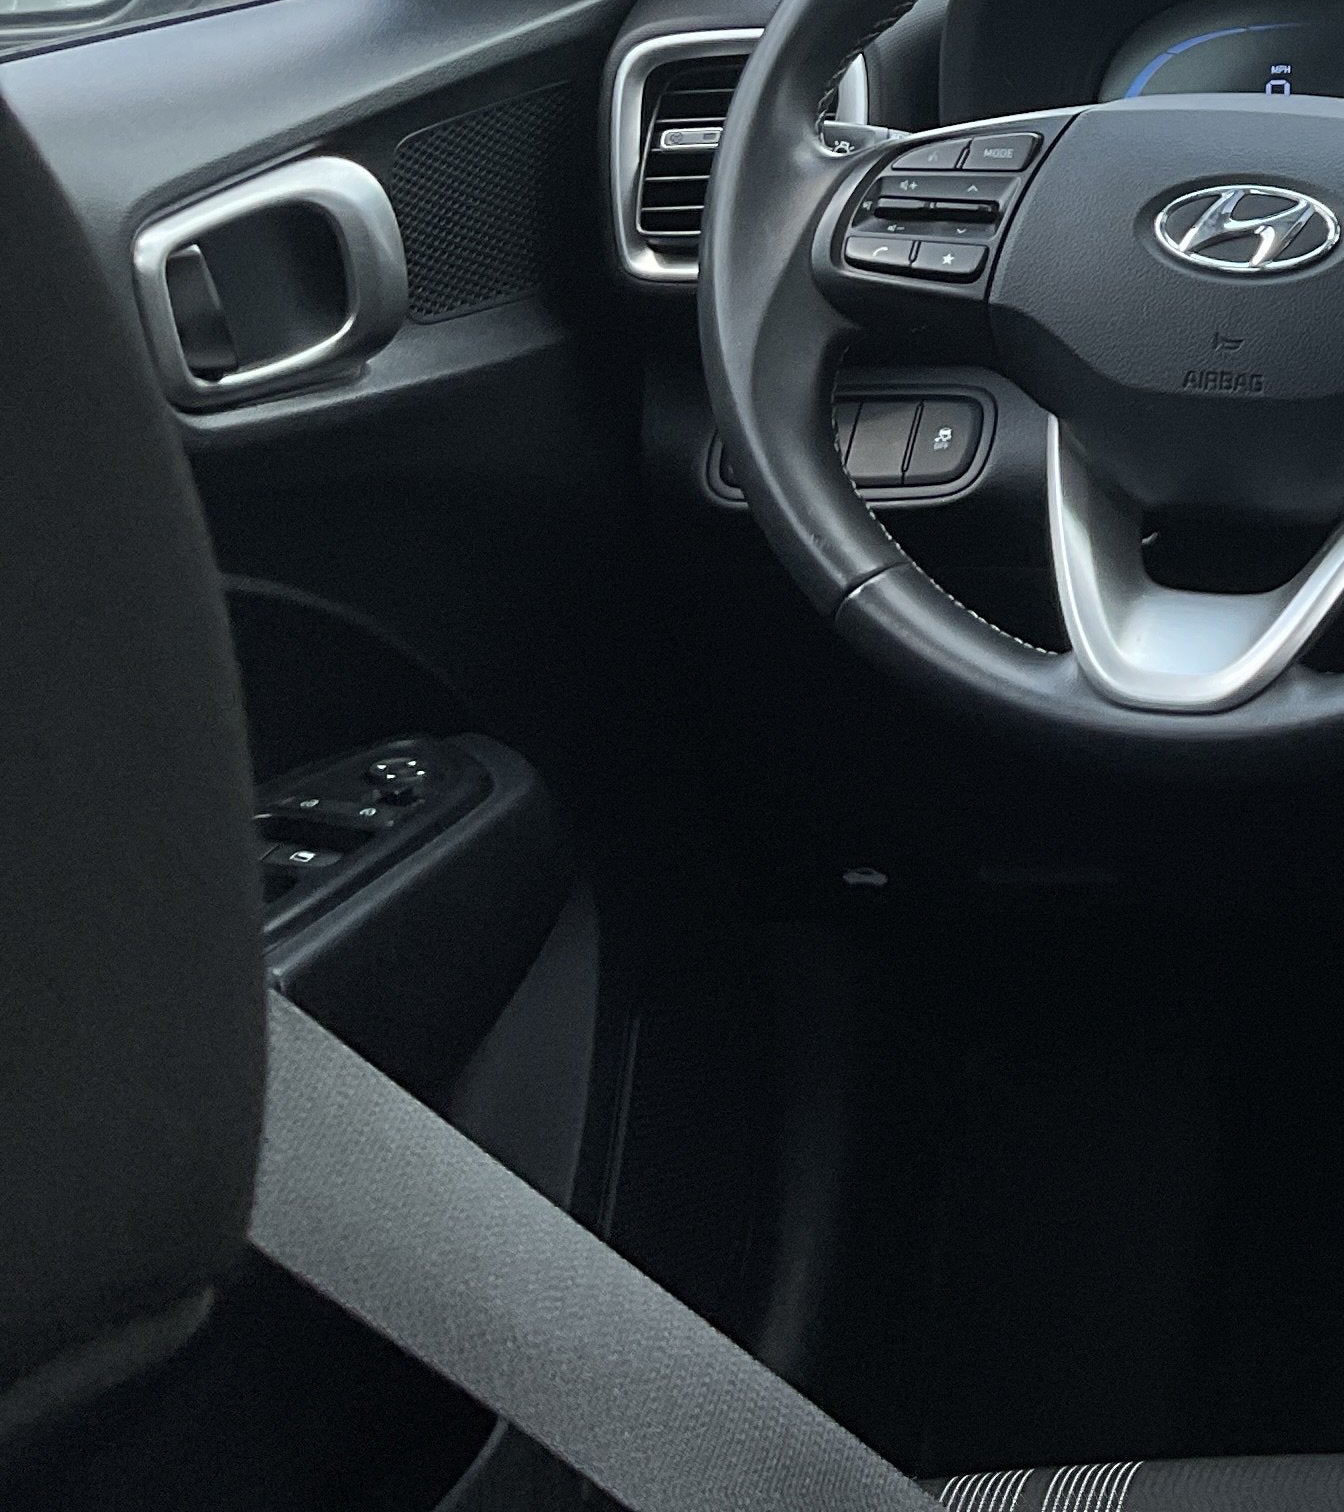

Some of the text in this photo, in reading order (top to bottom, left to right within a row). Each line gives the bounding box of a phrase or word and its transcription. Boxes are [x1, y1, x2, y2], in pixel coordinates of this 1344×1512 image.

[1271, 65, 1292, 74] MPH
[983, 148, 1015, 159] MODE
[1182, 370, 1265, 394] AIRBAG
